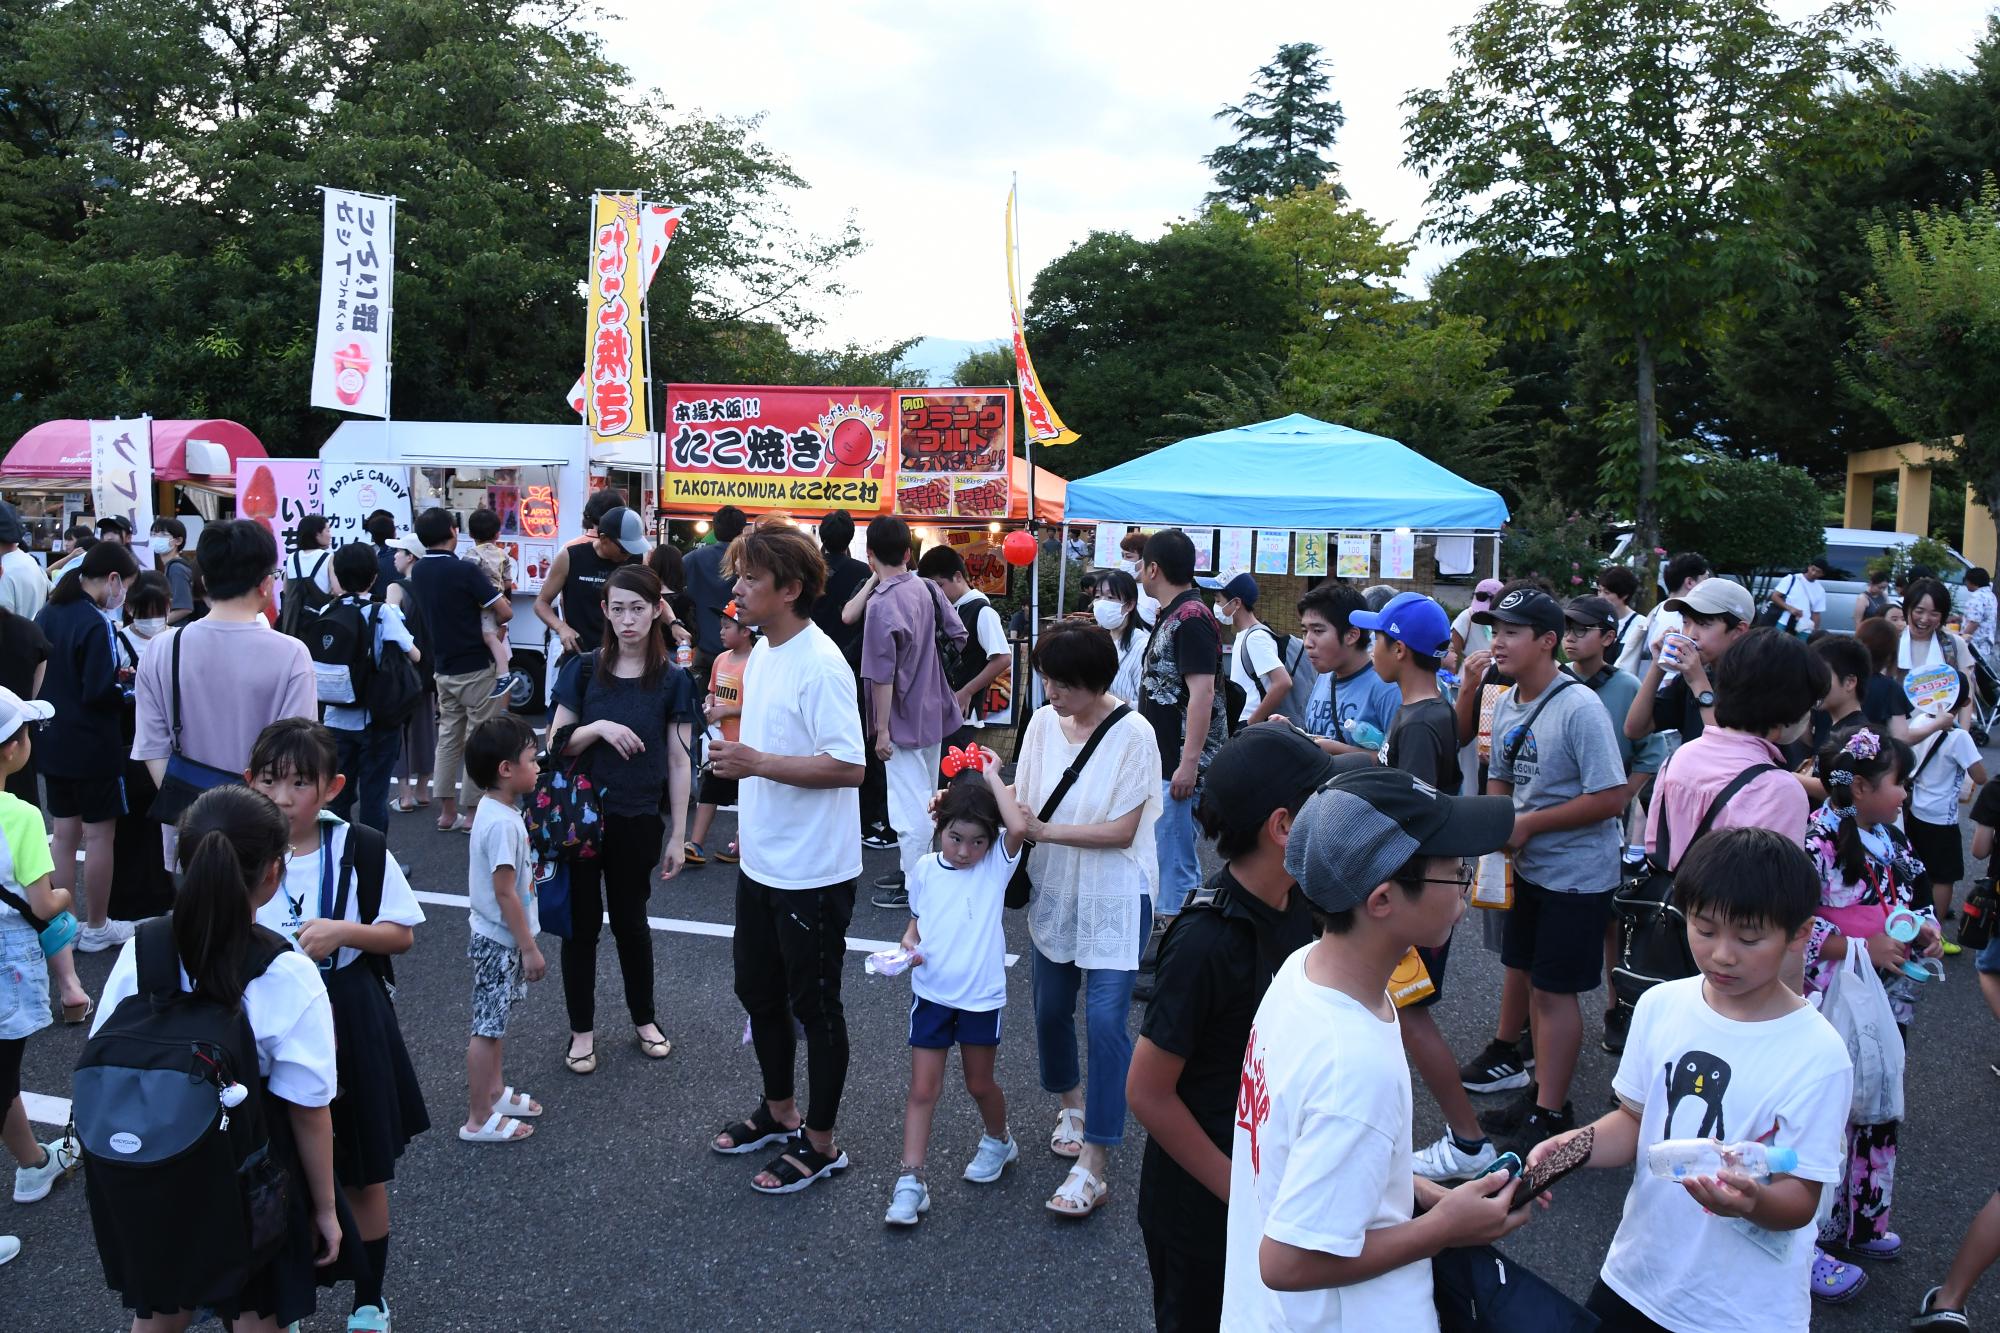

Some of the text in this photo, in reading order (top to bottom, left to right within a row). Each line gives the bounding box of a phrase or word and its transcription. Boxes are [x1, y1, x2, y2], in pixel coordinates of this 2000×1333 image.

[903, 405, 1004, 429] フランク
[673, 426, 823, 471] たこ焼き
[917, 429, 989, 452] フルト
[328, 469, 408, 500] APPLE CANDY
[673, 479, 786, 499] TAKOTAKOMURA
[789, 481, 879, 503] たこたこ村
[1305, 533, 1321, 569] お茶
